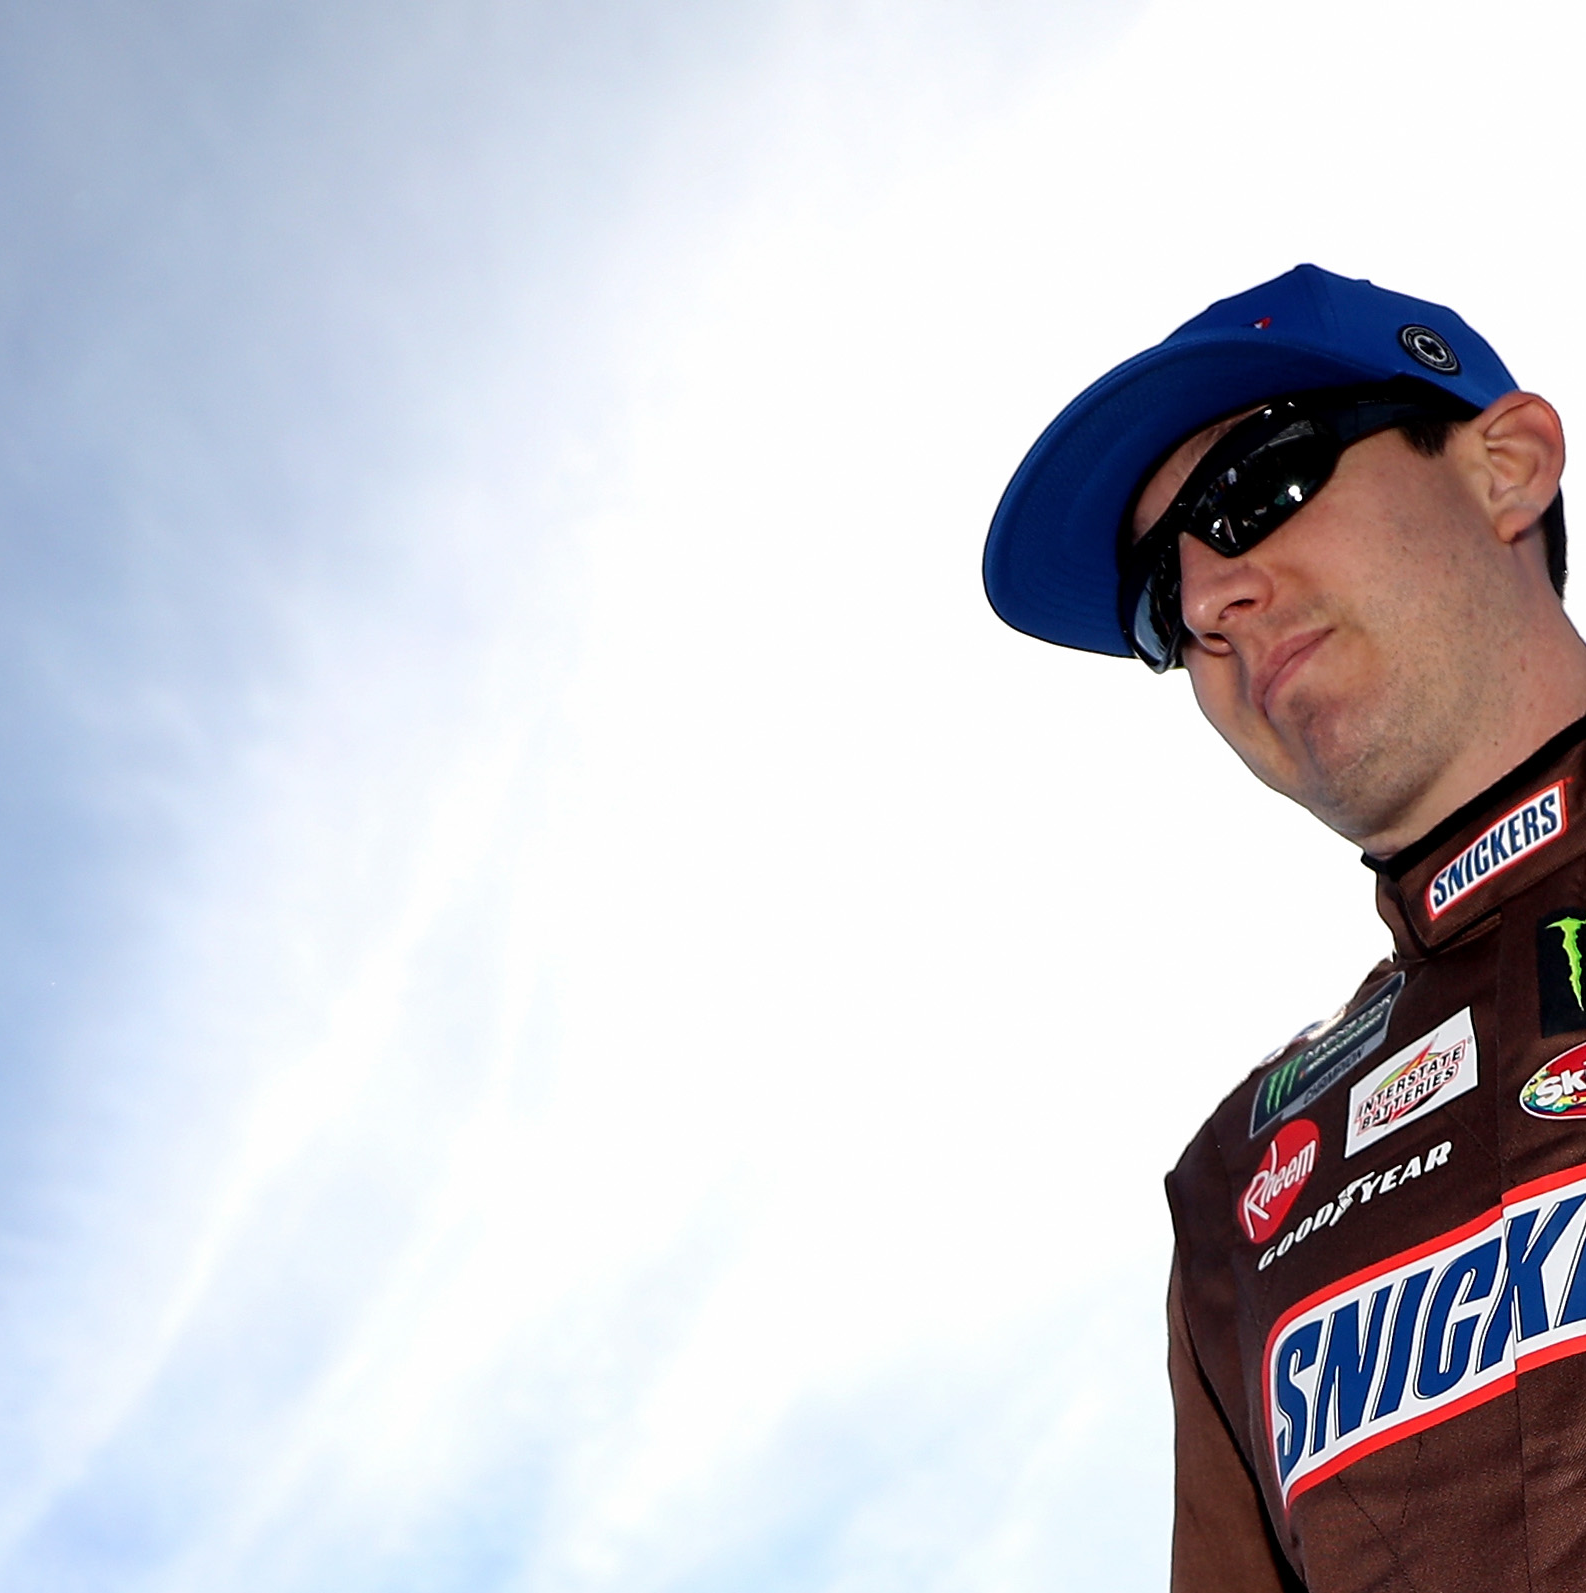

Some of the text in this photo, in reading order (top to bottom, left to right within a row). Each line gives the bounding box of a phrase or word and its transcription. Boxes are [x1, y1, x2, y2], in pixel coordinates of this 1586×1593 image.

[1432, 792, 1558, 908] SNICKERS
[1358, 1044, 1464, 1118] INTERSTATE
[1360, 1066, 1456, 1130] BATTERIES
[1243, 1140, 1316, 1239] Rheem
[1258, 1141, 1452, 1271] GOODYEAR
